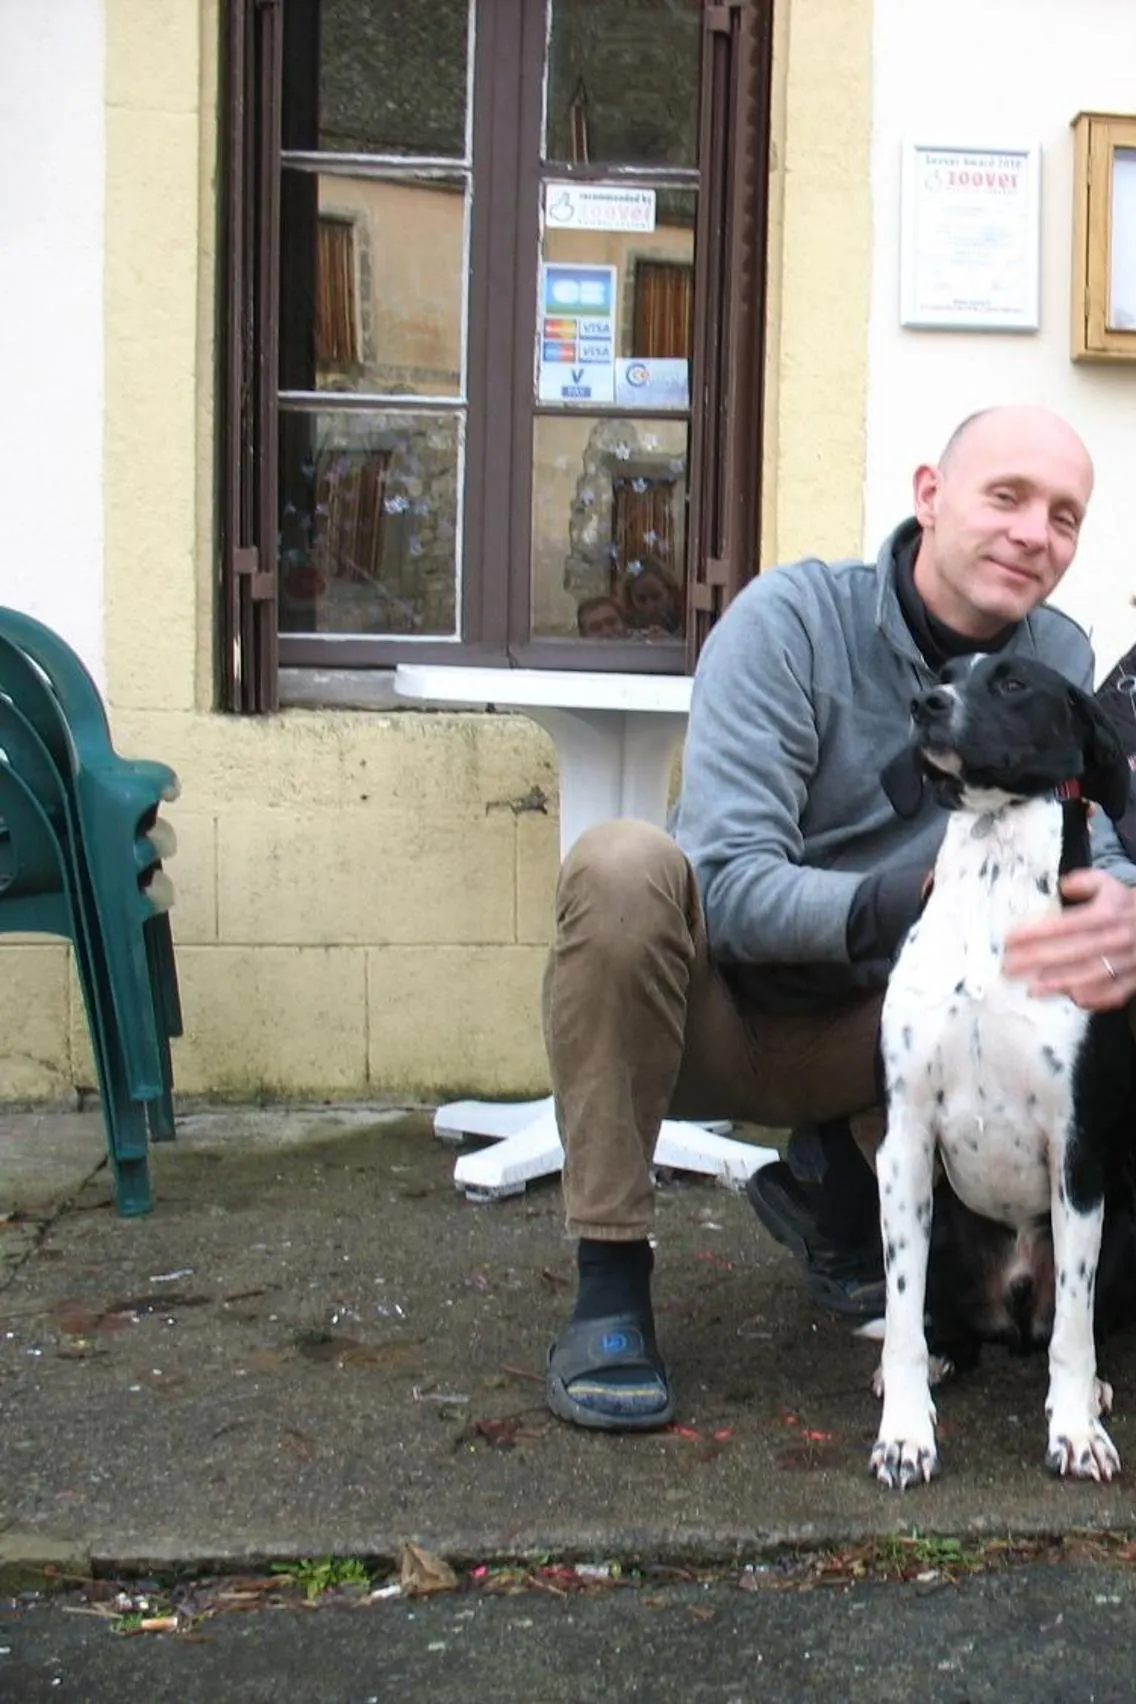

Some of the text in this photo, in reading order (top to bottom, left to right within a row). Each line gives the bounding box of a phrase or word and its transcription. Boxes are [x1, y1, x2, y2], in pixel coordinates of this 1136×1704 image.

[583, 323, 610, 333] VISA
[583, 346, 610, 357] VISA
[571, 368, 585, 384] V
